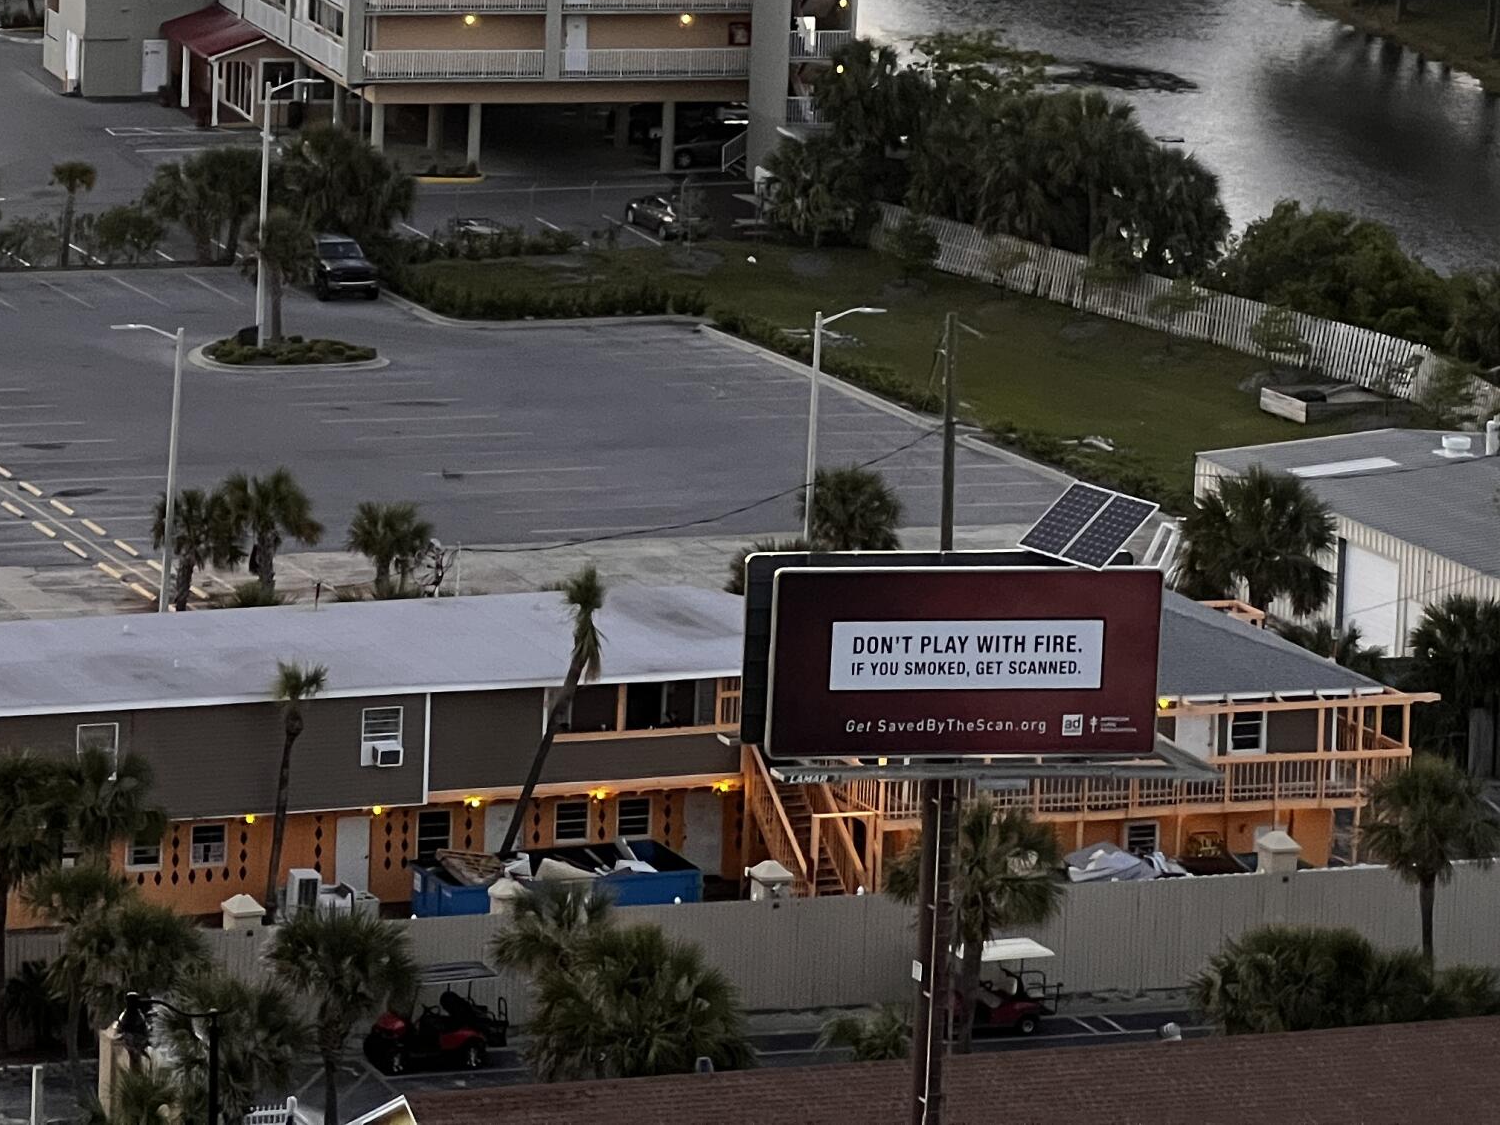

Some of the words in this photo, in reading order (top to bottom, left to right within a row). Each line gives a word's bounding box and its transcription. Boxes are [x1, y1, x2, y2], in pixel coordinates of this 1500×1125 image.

[852, 636, 913, 654] DON'T
[920, 635, 969, 654] PLAY
[977, 635, 1026, 653] WITH
[1034, 635, 1083, 653] FIRE.
[851, 662, 864, 676] IF
[870, 662, 899, 676] YOU
[904, 661, 970, 677] SMOKED,
[976, 661, 1003, 675] GET
[1008, 661, 1082, 675] SCANNED.
[845, 720, 871, 733] Get
[877, 719, 1047, 735] SavedByTheScan.org
[789, 774, 829, 784] LAMAR
